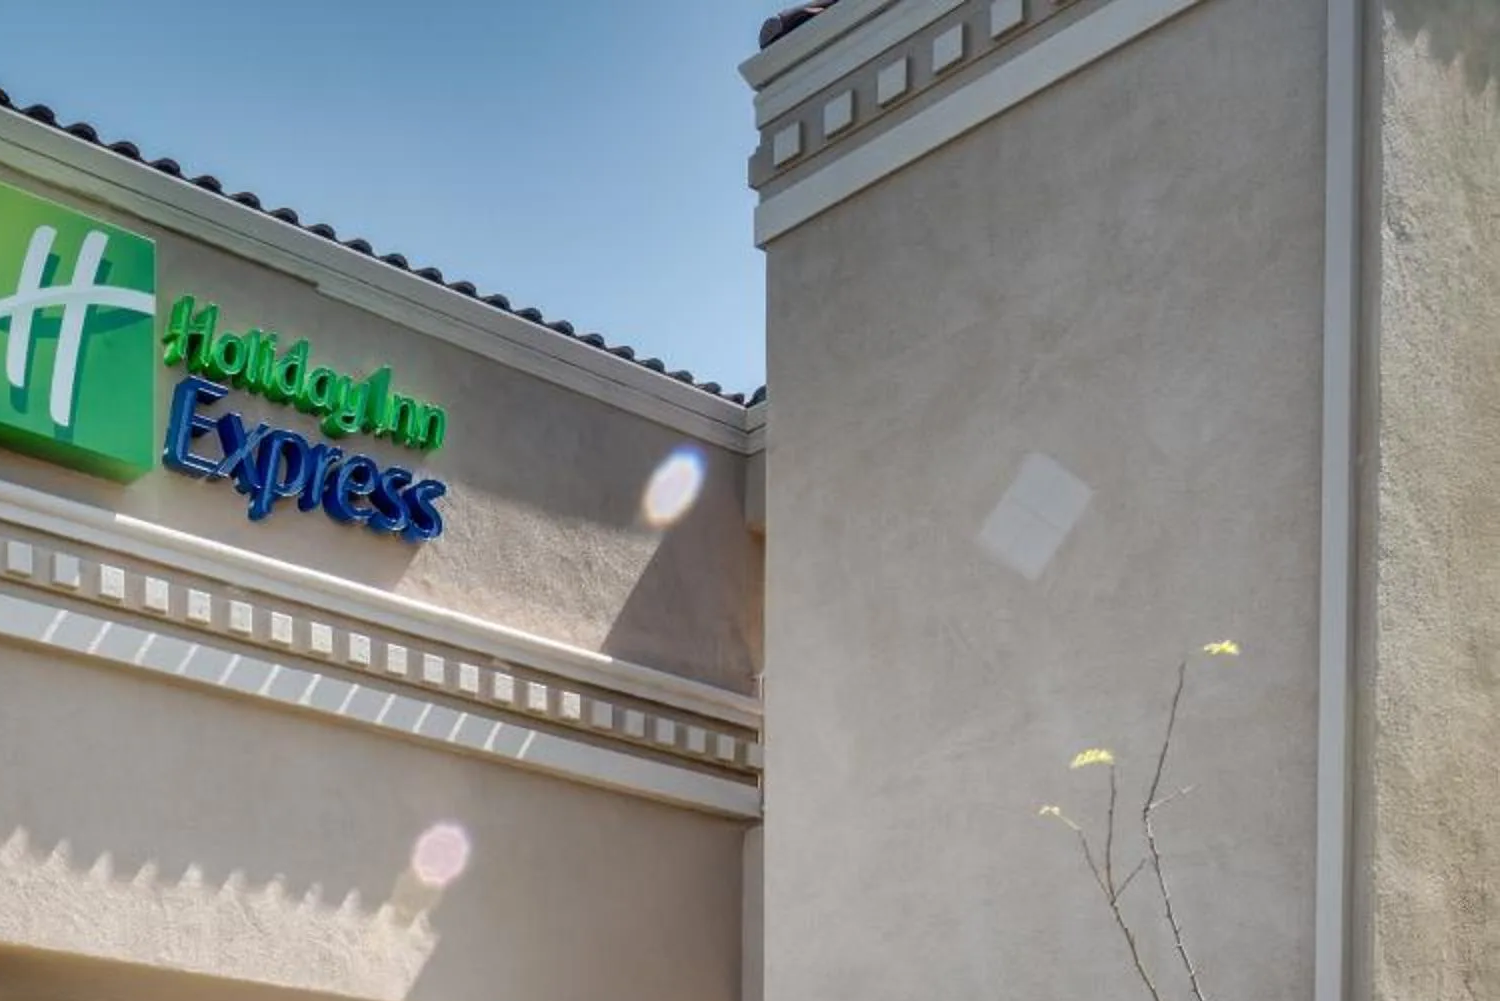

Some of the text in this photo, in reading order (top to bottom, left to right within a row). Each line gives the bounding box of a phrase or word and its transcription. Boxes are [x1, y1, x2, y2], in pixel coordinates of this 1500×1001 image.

[162, 296, 447, 452] Holiday Inn
[162, 375, 447, 543] Express
